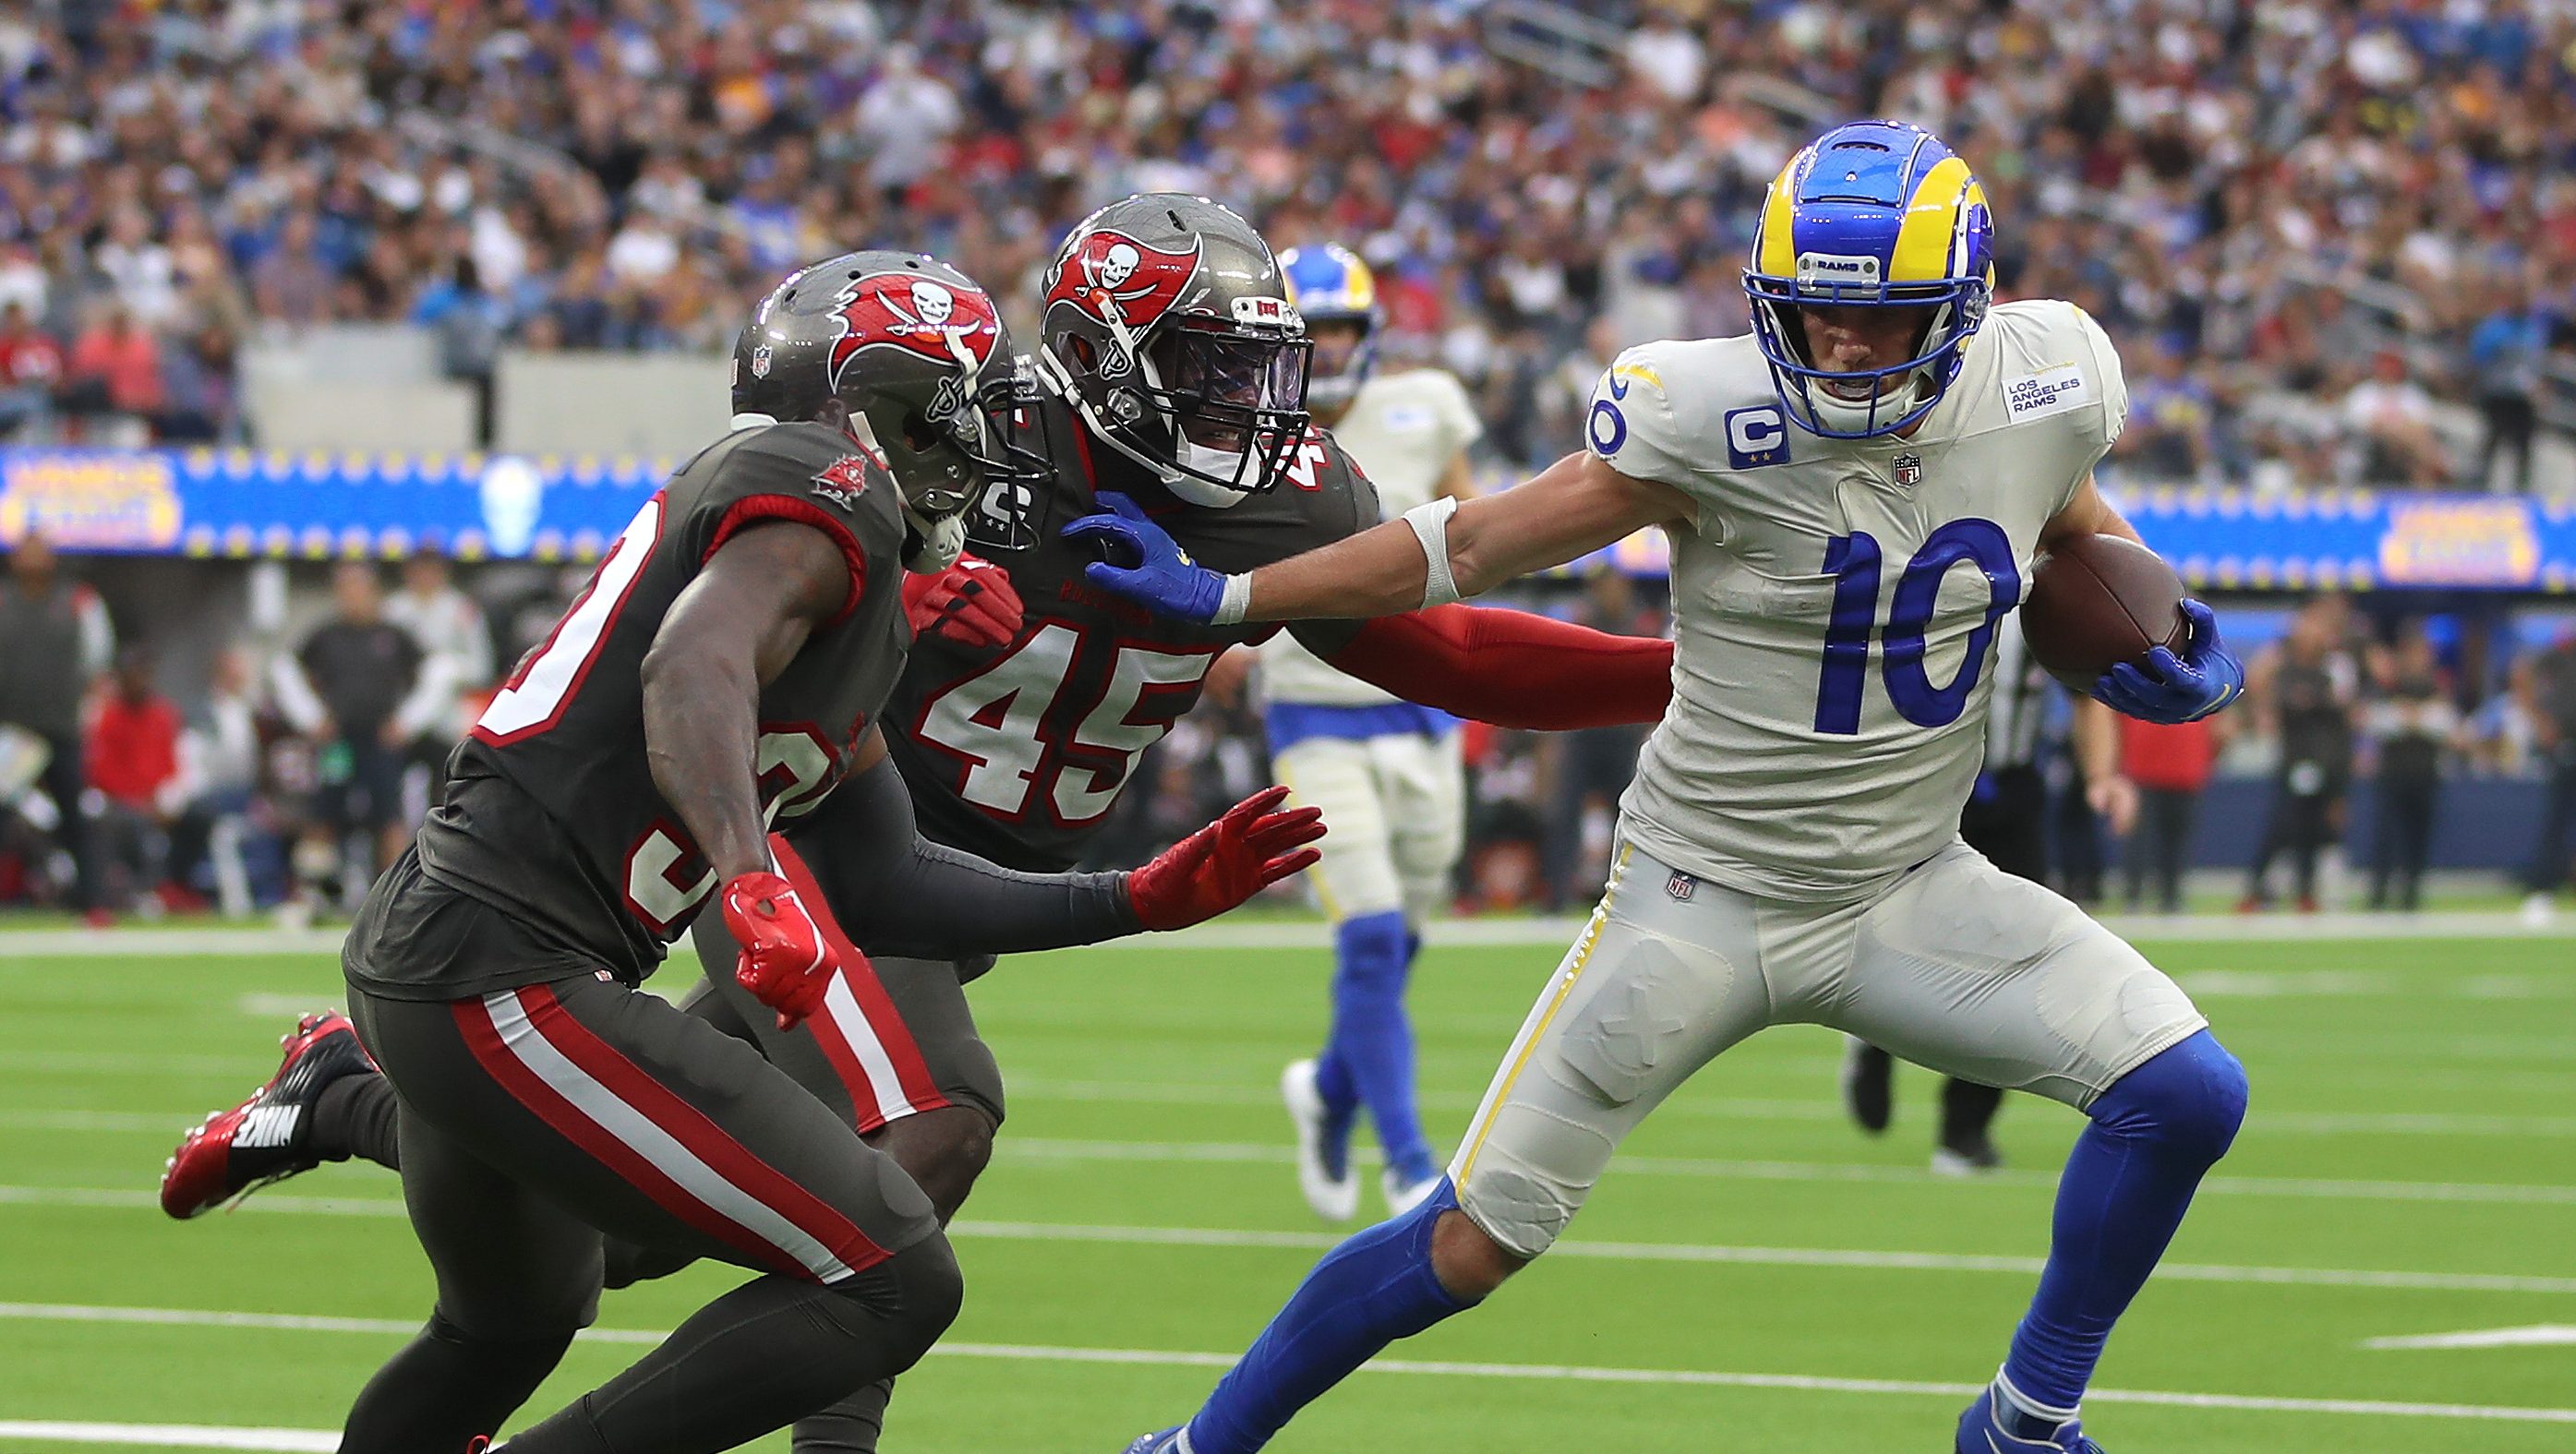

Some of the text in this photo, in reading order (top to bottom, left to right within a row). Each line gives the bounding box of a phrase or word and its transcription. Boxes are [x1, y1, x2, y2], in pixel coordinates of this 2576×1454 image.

[1817, 260, 1860, 272] RAMS
[2008, 379, 2038, 394] LOS
[2012, 379, 2080, 403] ANGELES
[2013, 394, 2057, 413] RAMS
[1729, 409, 1783, 454] C
[1813, 517, 2022, 736] 10
[916, 620, 1215, 822] 45
[231, 1104, 302, 1148] NIKE
